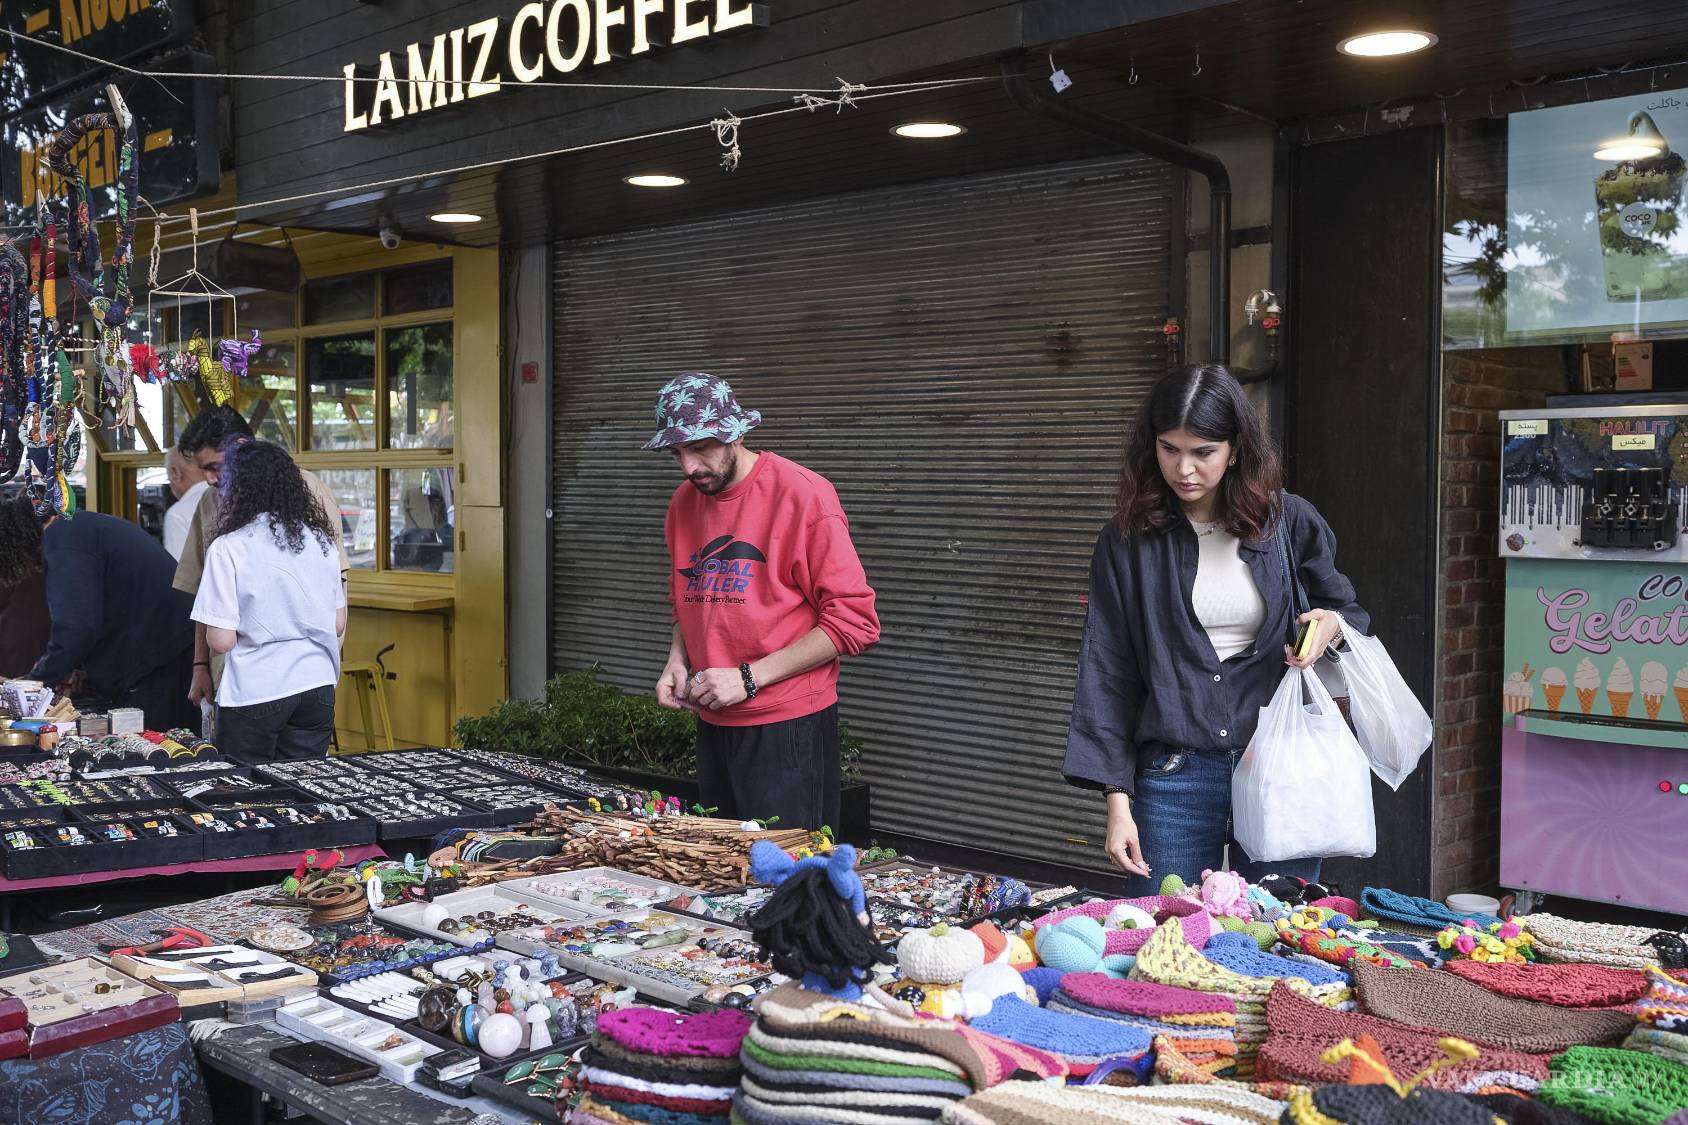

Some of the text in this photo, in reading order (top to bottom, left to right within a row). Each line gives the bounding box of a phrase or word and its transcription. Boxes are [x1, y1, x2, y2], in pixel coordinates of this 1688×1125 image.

[343, 17, 502, 133] LAMIZ
[1624, 213, 1651, 223] COCO
[1638, 574, 1688, 602] CO
